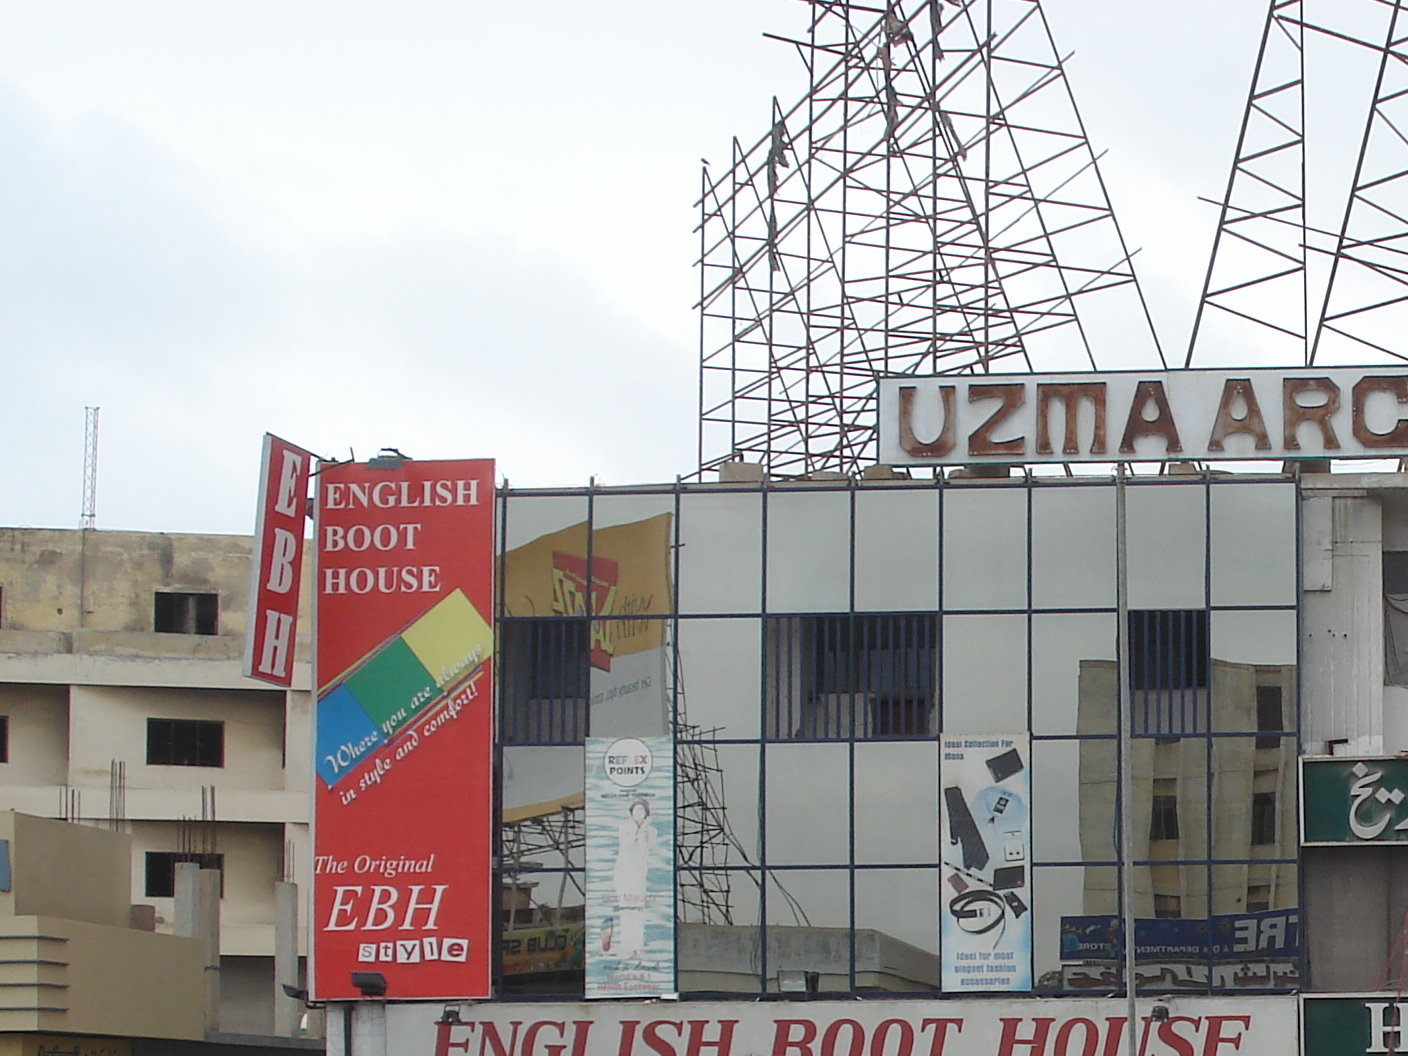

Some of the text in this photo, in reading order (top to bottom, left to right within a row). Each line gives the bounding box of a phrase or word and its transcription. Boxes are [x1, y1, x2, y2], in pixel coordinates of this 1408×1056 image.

[897, 379, 1183, 457] UZMA
[325, 479, 480, 509] ENGLISH
[323, 523, 422, 552] BOOT
[258, 449, 302, 678] EBH
[322, 566, 441, 594] HOUSE
[324, 643, 483, 774] Where you are always
[339, 681, 479, 806] in style and comfort!
[608, 755, 648, 765] REFEX
[609, 766, 646, 775] POINTS
[315, 854, 435, 878] The Original
[322, 884, 450, 931] EBH
[361, 941, 465, 961] style
